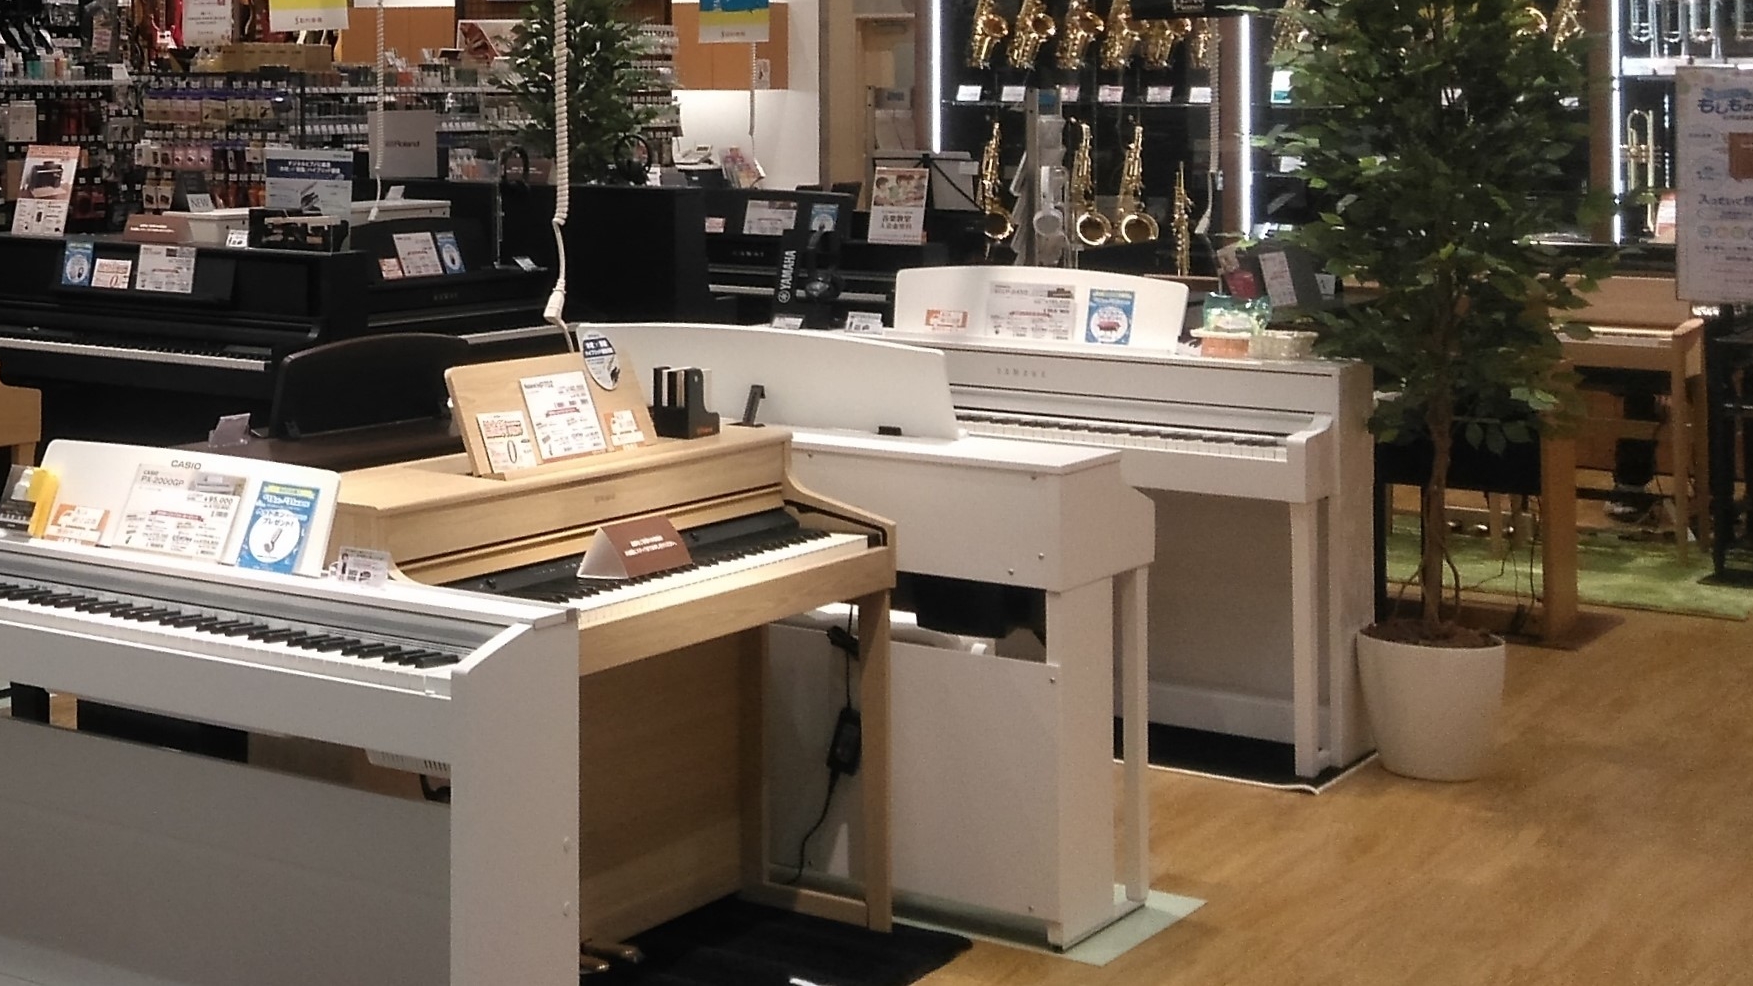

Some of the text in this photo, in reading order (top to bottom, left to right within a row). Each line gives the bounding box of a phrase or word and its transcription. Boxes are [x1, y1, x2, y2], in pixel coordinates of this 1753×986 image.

[396, 140, 420, 148] Roland
[780, 250, 797, 290] YAMAHA
[171, 460, 202, 470] CASIO
